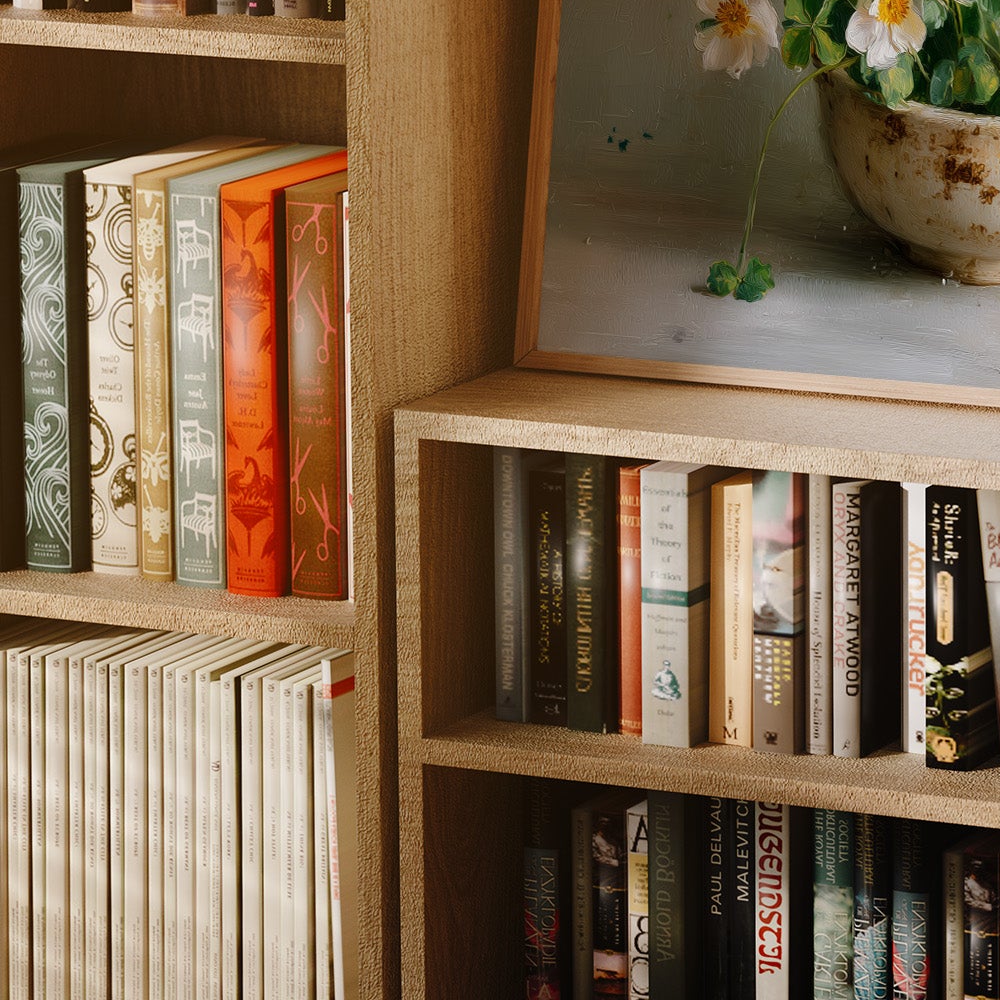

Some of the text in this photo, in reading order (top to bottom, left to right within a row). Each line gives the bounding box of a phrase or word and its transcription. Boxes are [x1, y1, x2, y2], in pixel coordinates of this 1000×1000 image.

[651, 537, 681, 549] Theory
[662, 555, 671, 563] of
[943, 504, 962, 565] Shriek:
[502, 455, 514, 691] DOWNTOWN OWL CHUCK KLOSTERMAN
[650, 571, 682, 582] Fiction
[834, 492, 846, 669] ORYX AND CRAKE
[846, 493, 860, 696] MARGARET ATWOOD
[723, 726, 738, 740] M
[710, 799, 722, 915] PAUL DELVAU
